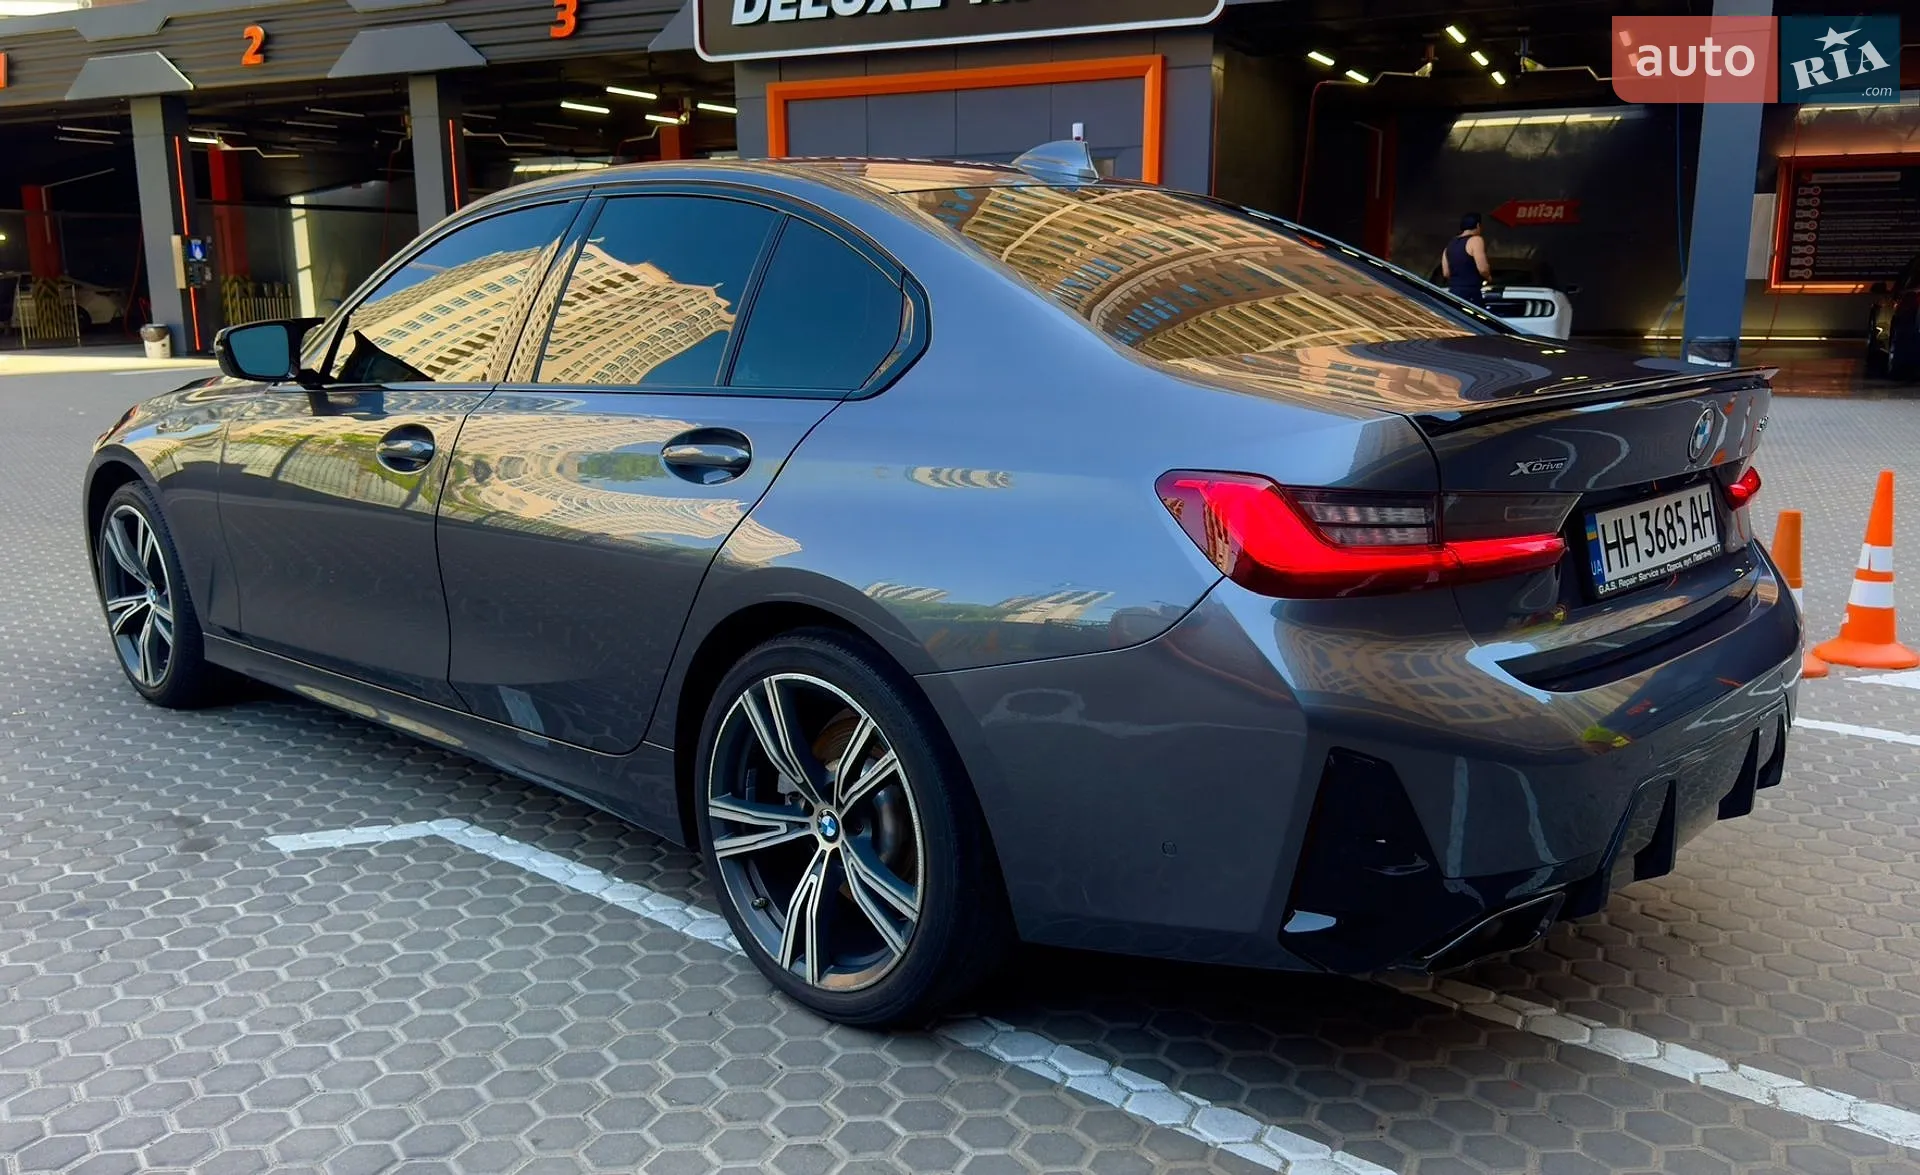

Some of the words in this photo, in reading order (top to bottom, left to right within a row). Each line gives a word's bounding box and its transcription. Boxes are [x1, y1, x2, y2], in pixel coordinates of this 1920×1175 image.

[549, 0, 578, 39] 3
[731, 0, 941, 25] DEL
[241, 23, 265, 66] 2
[1601, 515, 1641, 572] HH
[1640, 501, 1687, 558] 3685
[1690, 492, 1714, 542] AH
[1591, 560, 1603, 575] UA
[1618, 576, 1637, 588] Repair
[1638, 570, 1659, 581] Service
